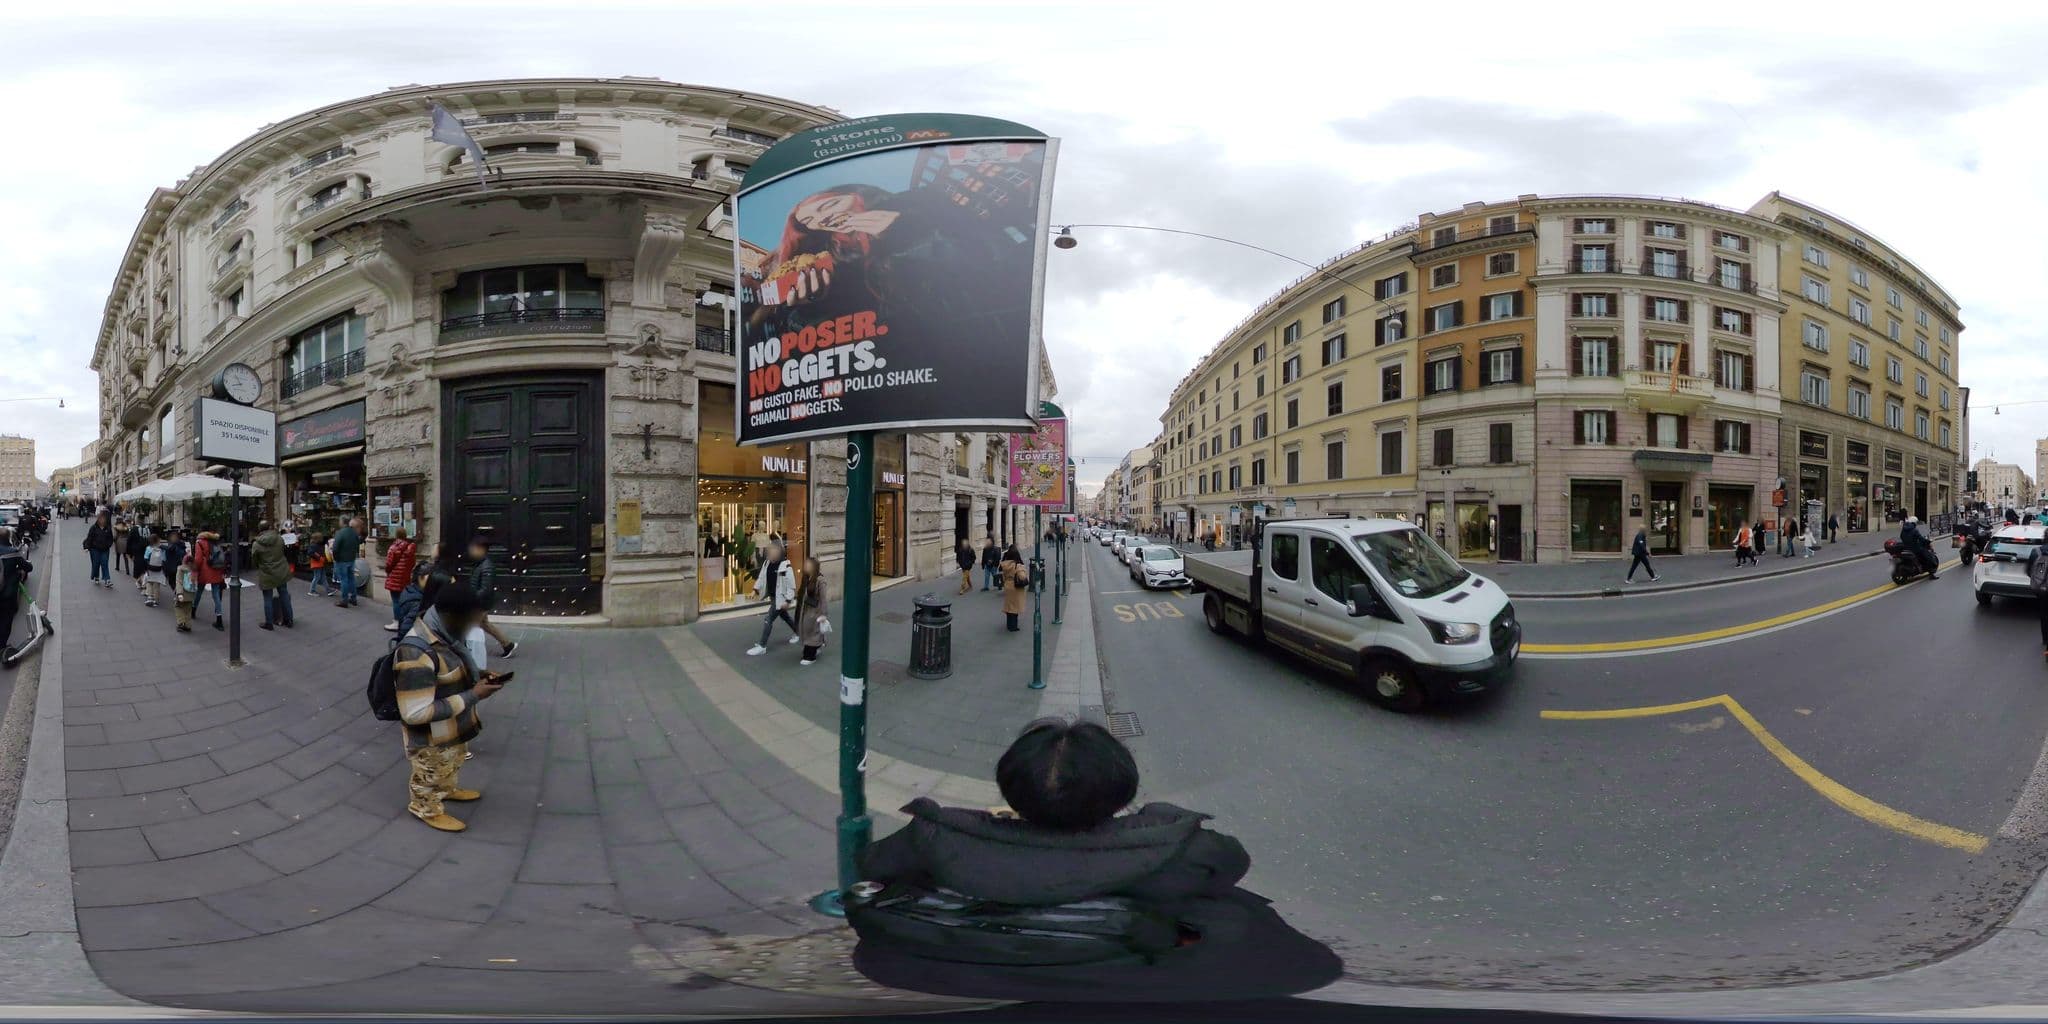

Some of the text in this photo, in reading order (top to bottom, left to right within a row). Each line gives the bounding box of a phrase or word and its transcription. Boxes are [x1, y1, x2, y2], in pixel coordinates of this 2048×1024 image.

[814, 117, 879, 133] fermata
[811, 126, 895, 147] Tritone
[813, 134, 903, 158] (Barberini)
[750, 340, 886, 397] NOGGETS.
[750, 368, 937, 413] NO GUSTO FAKE, NO POLLO SHAKE.
[750, 398, 843, 427] CHIAMALI NOGGETS.
[210, 419, 233, 429] SPAZIO
[762, 455, 806, 474] NUNA LIE
[1014, 452, 1060, 461] FLOWERS
[883, 471, 905, 485] NUNA LIE
[1113, 602, 1184, 623] BUS
